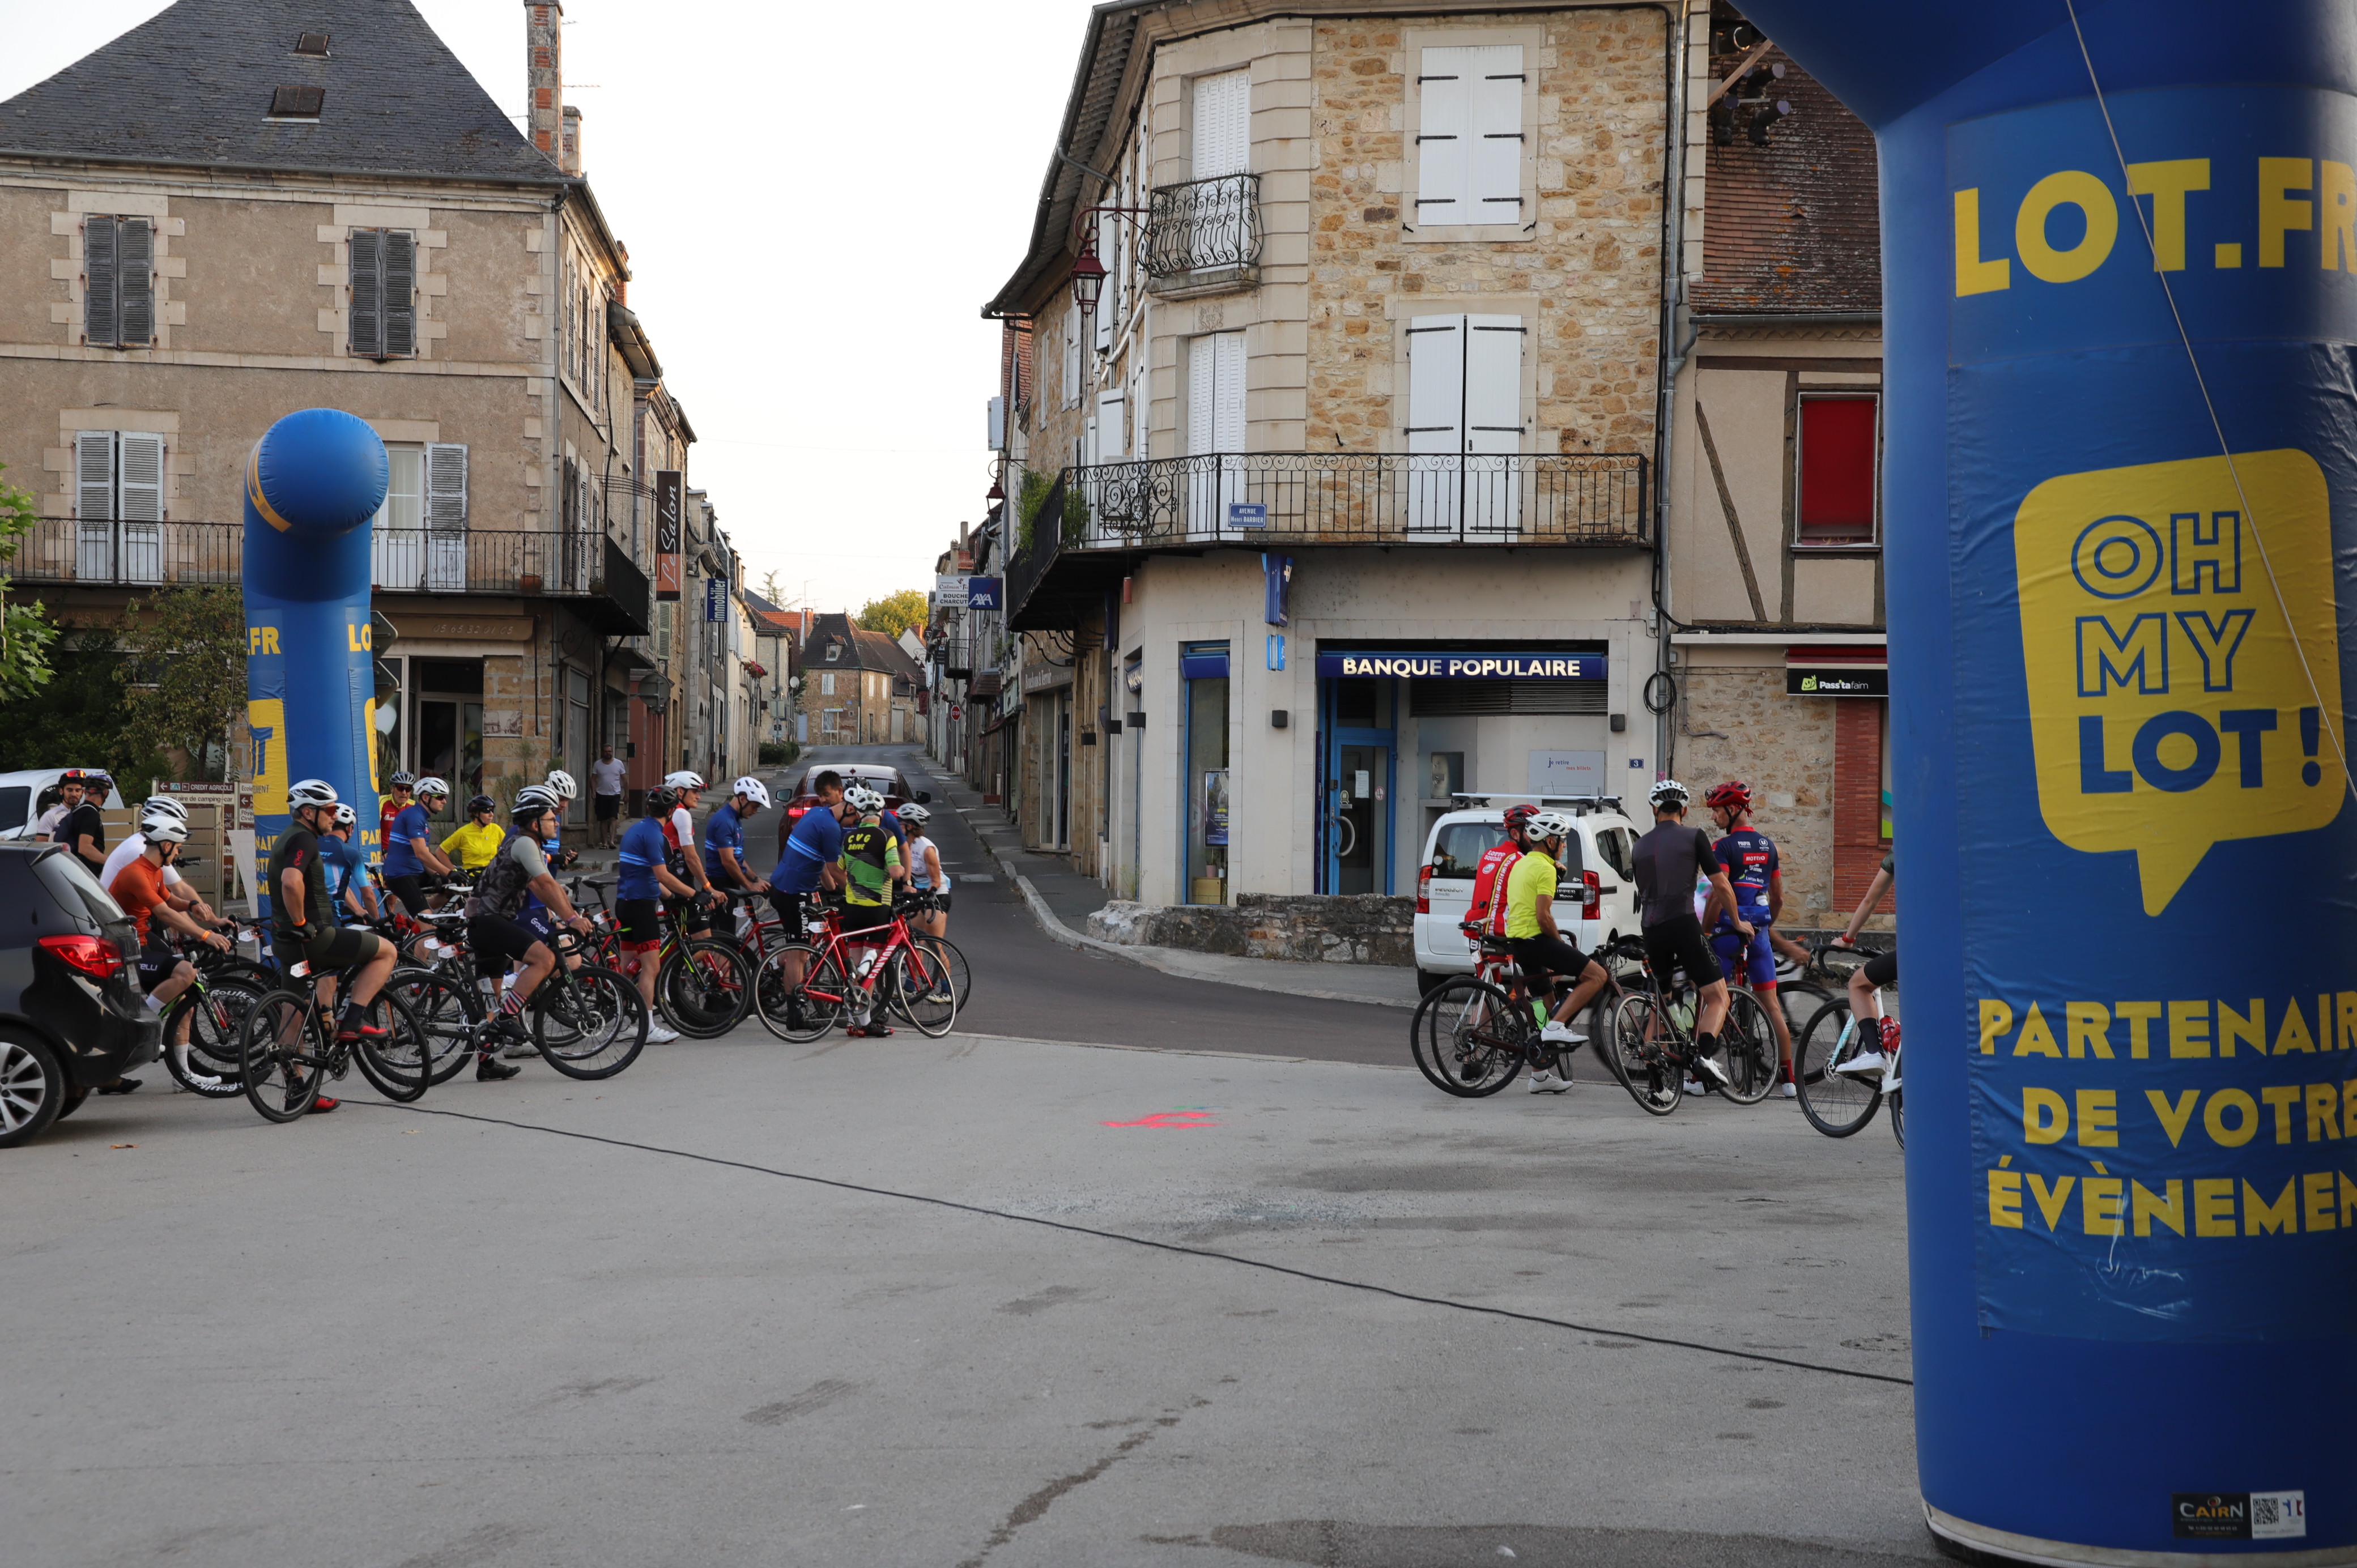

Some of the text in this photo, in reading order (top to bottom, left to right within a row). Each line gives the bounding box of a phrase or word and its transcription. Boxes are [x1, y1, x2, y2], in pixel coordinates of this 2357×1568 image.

[661, 485, 677, 551] Salon
[2071, 511, 2241, 599] OH
[710, 579, 725, 621] immobilier
[968, 593, 993, 606] AXA
[1343, 658, 1580, 678] BANQUE POPULAIRE
[2075, 608, 2256, 697] MY
[867, 945, 896, 978] CANYON
[2023, 1087, 2118, 1147] DE
